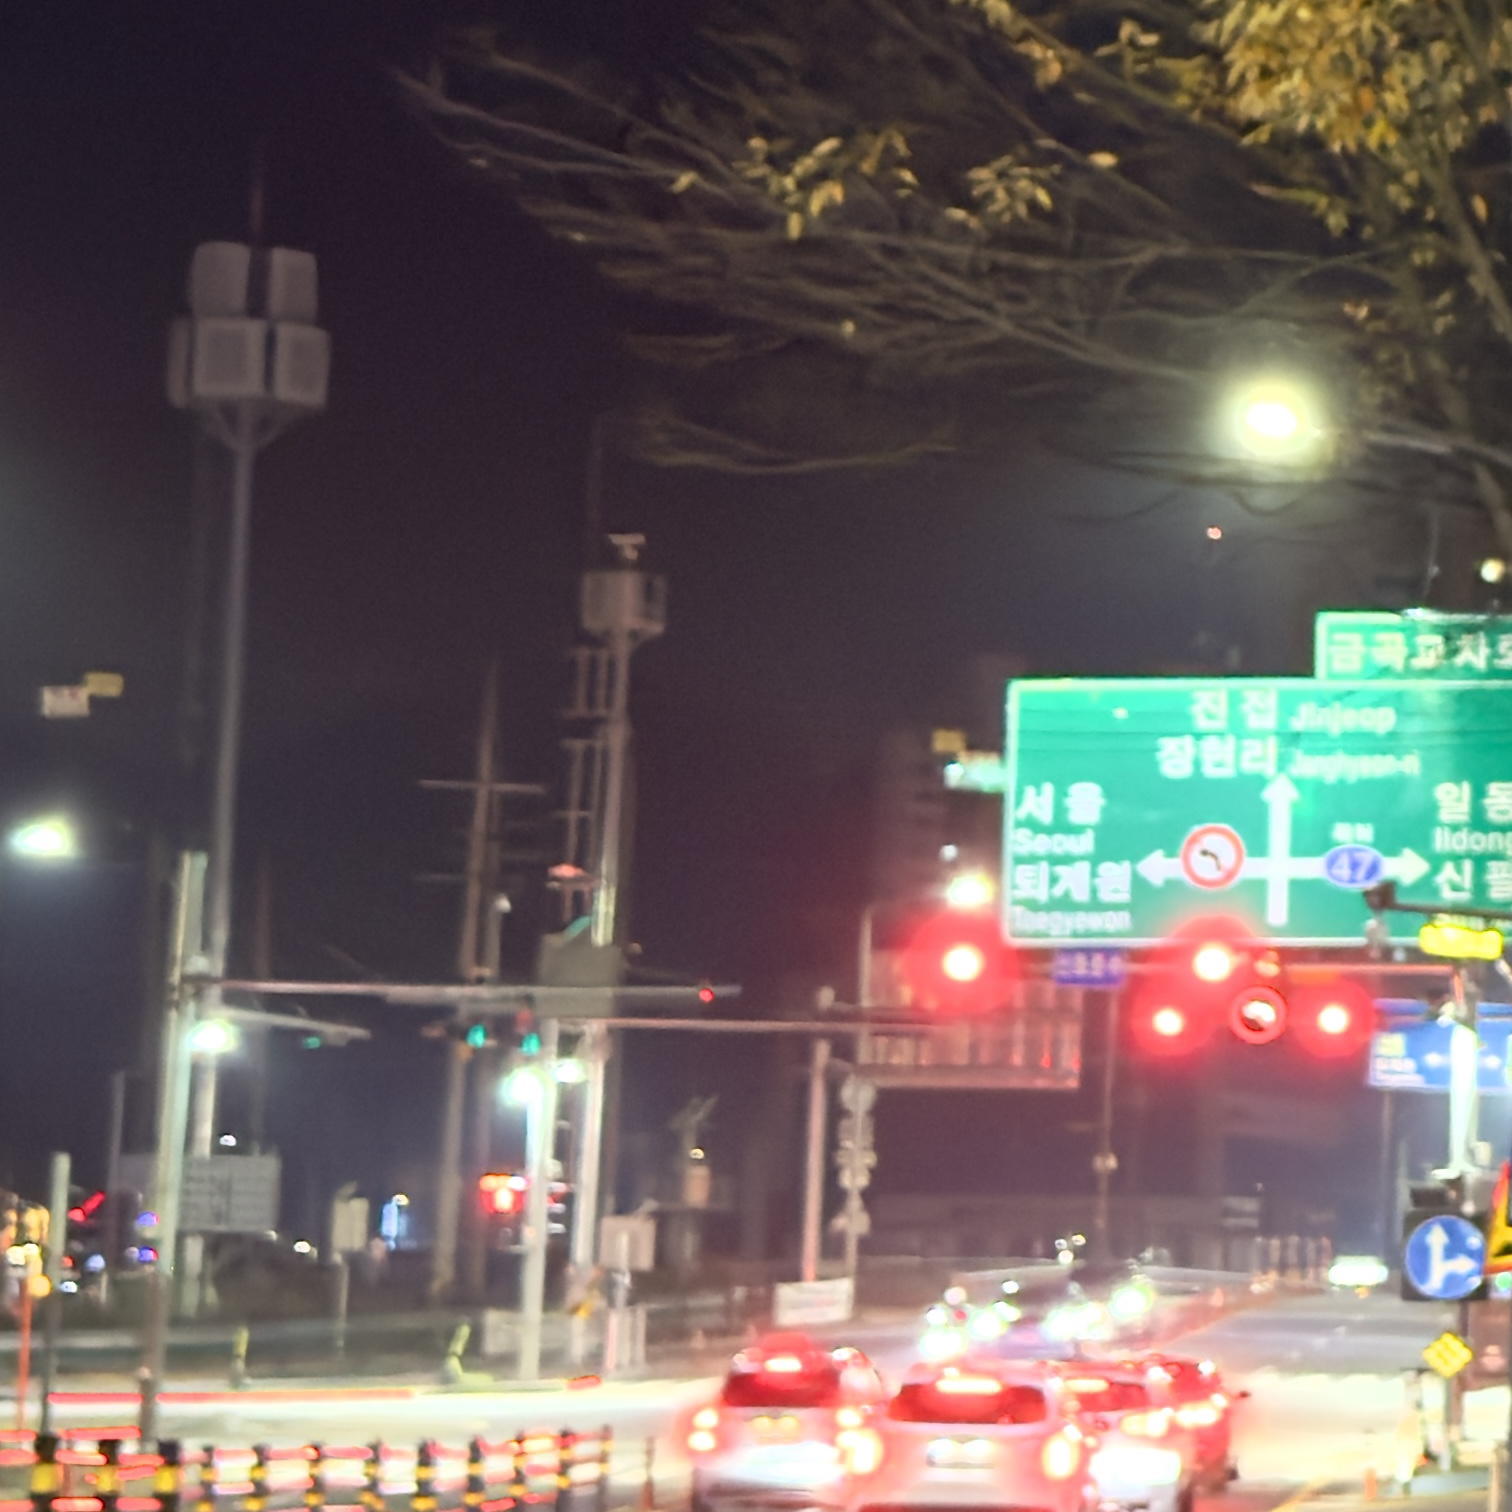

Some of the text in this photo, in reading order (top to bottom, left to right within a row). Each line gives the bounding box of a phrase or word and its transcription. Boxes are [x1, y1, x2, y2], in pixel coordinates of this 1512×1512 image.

[1014, 781, 1107, 827] 서울
[1013, 827, 1095, 857] Seoul
[1012, 859, 1133, 905] 퇴계원
[1331, 850, 1376, 883] 47
